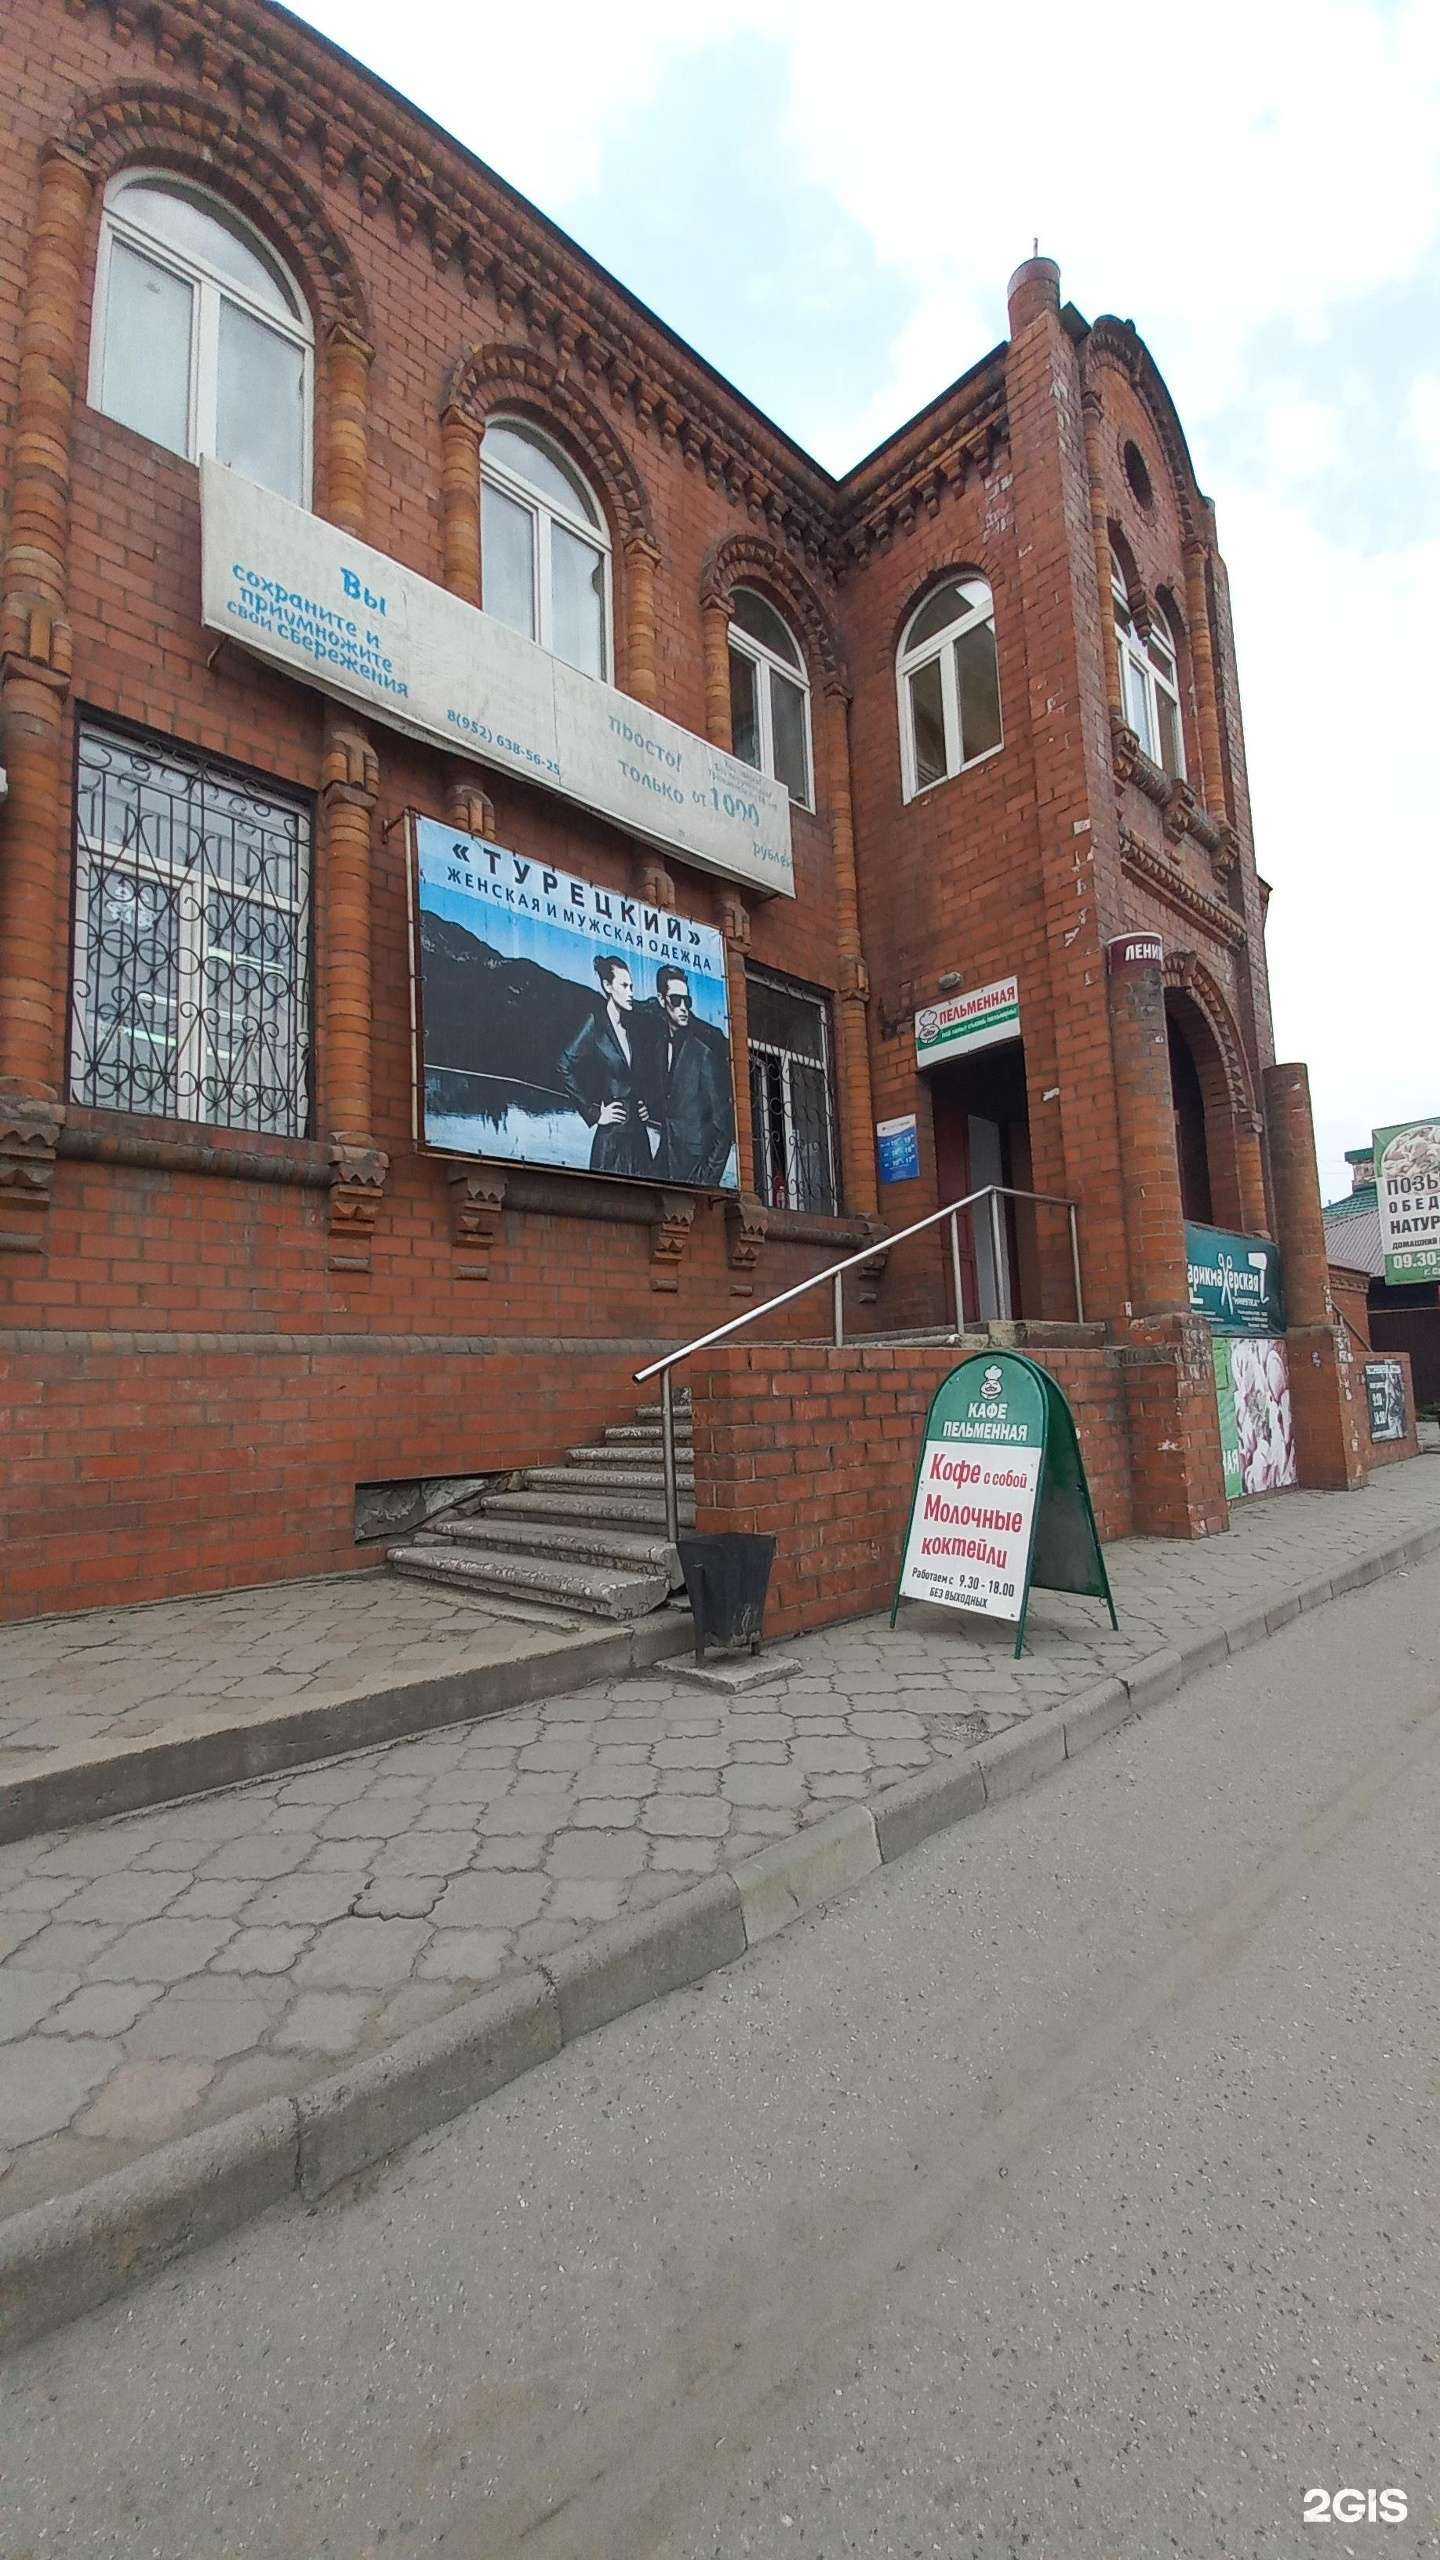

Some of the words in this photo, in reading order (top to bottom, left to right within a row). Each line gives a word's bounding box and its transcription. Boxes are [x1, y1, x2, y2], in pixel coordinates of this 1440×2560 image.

[232, 564, 357, 637] сохраните
[366, 630, 380, 649] и
[340, 566, 387, 617] Вы
[227, 600, 272, 632] свои
[277, 623, 409, 697] сбережения
[239, 587, 393, 673] приумножите
[447, 709, 492, 743] 8(952)
[618, 760, 684, 804] только
[452, 843, 701, 946] «ТУРЕЦКИЙ»
[447, 866, 540, 912] ЖЕНСКАЯ
[547, 902, 557, 918] И
[563, 909, 644, 949] МУЖСКАЯ
[649, 940, 712, 971] ОДЕЖДА
[940, 986, 1016, 1025] ПЕЛЬМЕННАЯ
[967, 1401, 1008, 1420] КАФЕ
[943, 1421, 1028, 1441] ПЕЛЬМЕННАЯ
[929, 1453, 982, 1490] Кофе
[983, 1472, 991, 1485] с
[992, 1469, 1028, 1488] собой
[923, 1493, 1023, 1533] Молочные
[920, 1536, 1008, 1569] коктейли
[911, 1567, 948, 1584] Работаем
[948, 1577, 954, 1585] с
[959, 1574, 980, 1590] 9.30
[988, 1579, 1015, 1597] 18.00
[929, 1587, 943, 1599] БЕЗ
[944, 1590, 988, 1608] ВЫХОДНЫХ
